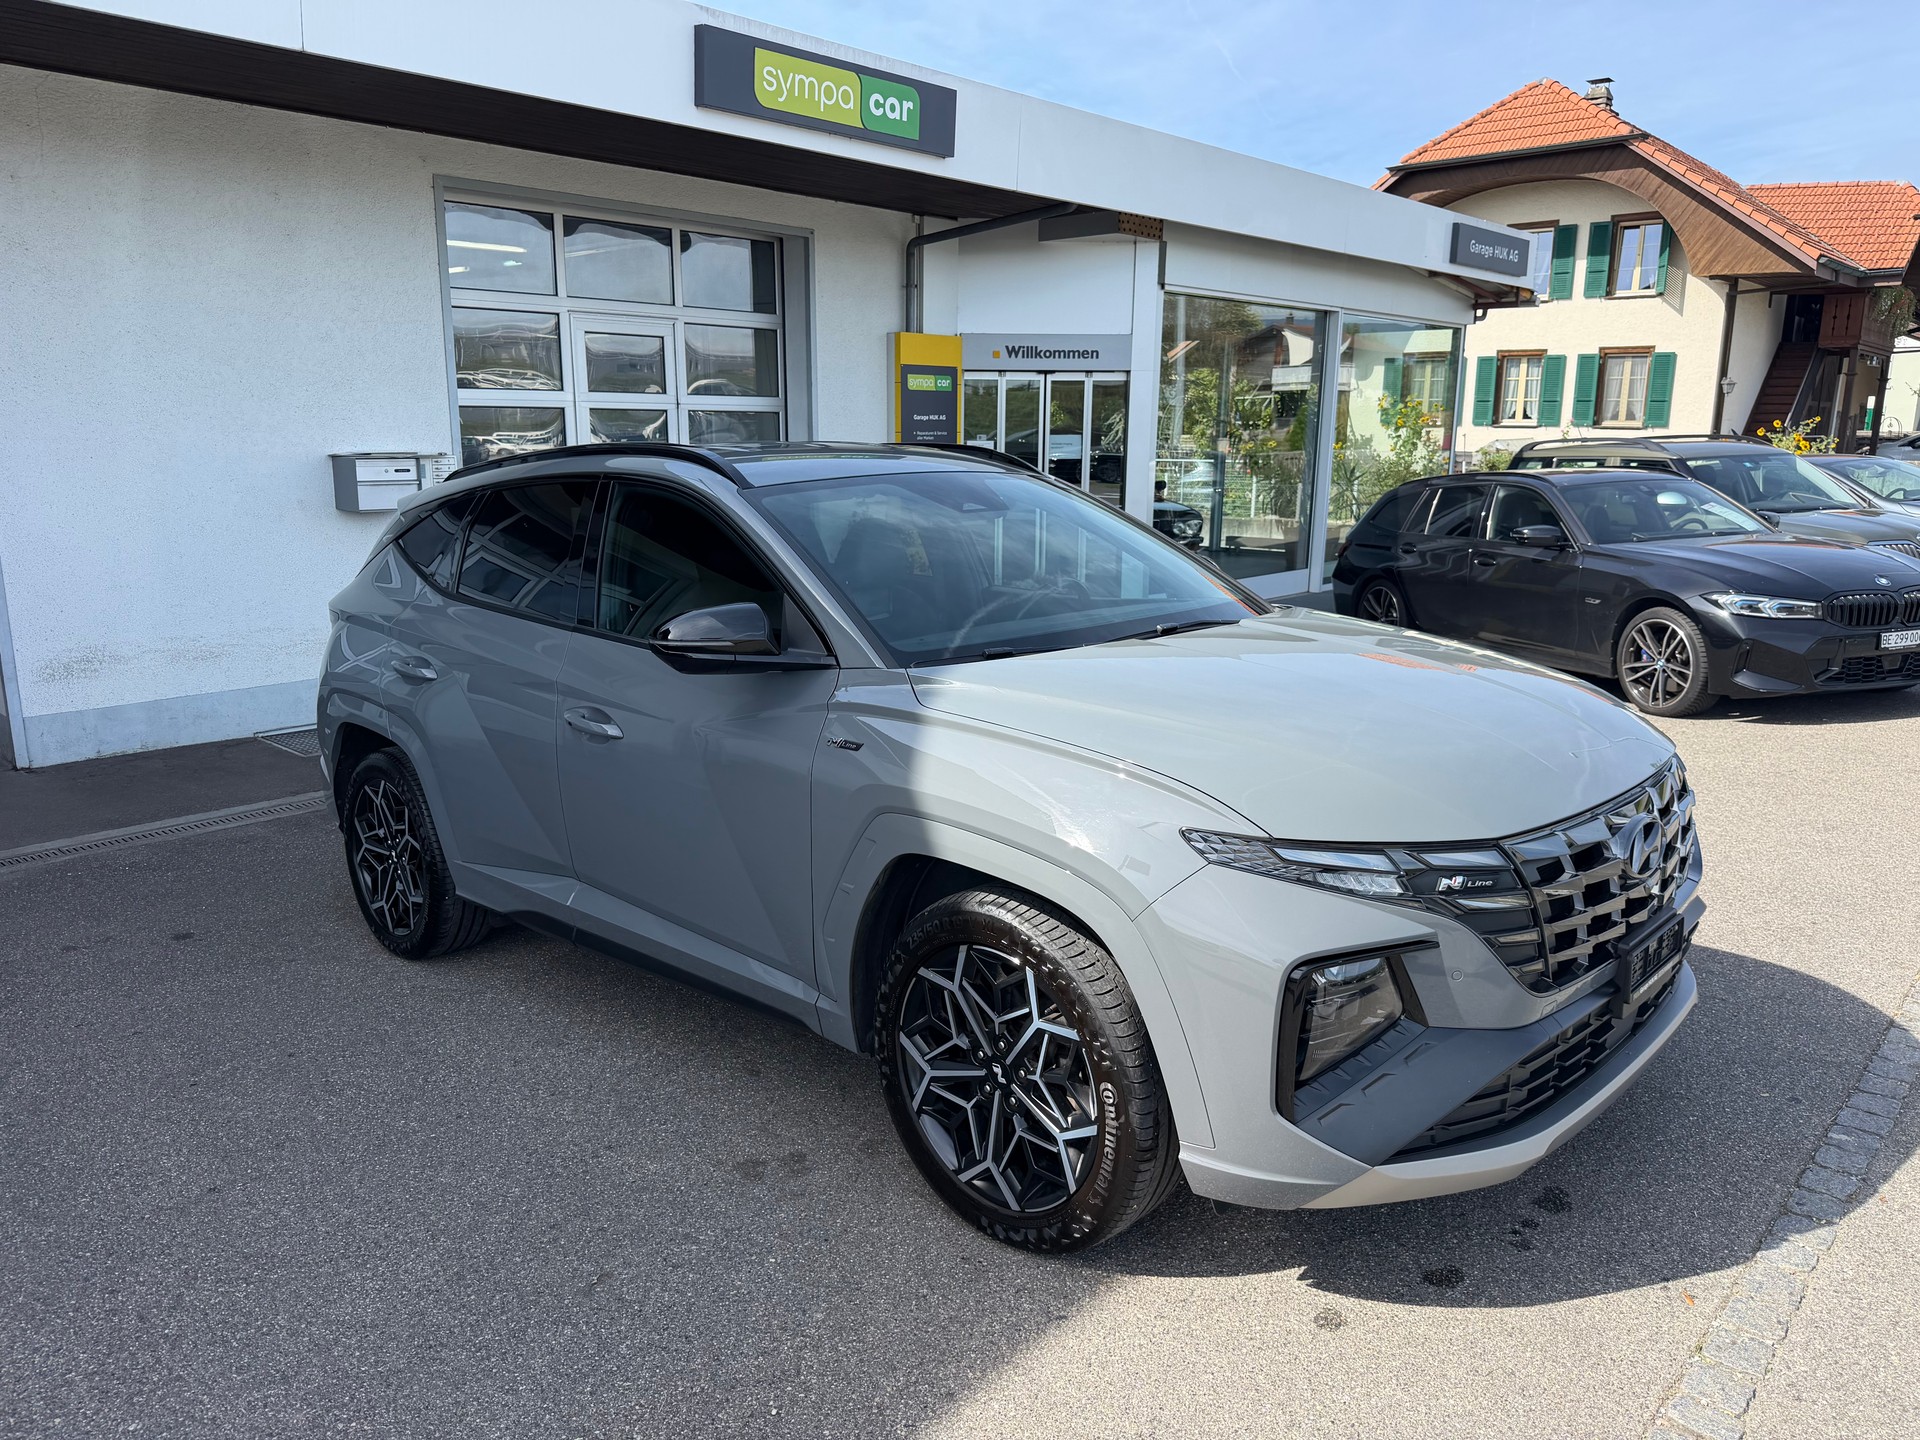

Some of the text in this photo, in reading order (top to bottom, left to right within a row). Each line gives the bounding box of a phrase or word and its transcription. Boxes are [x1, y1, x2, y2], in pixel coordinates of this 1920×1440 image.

[763, 66, 914, 122] sympa car
[1470, 240, 1519, 262] Garage HUK AG
[1005, 345, 1099, 360] Willkommen
[909, 378, 950, 389] sympa car
[1094, 1081, 1125, 1197] Continental
